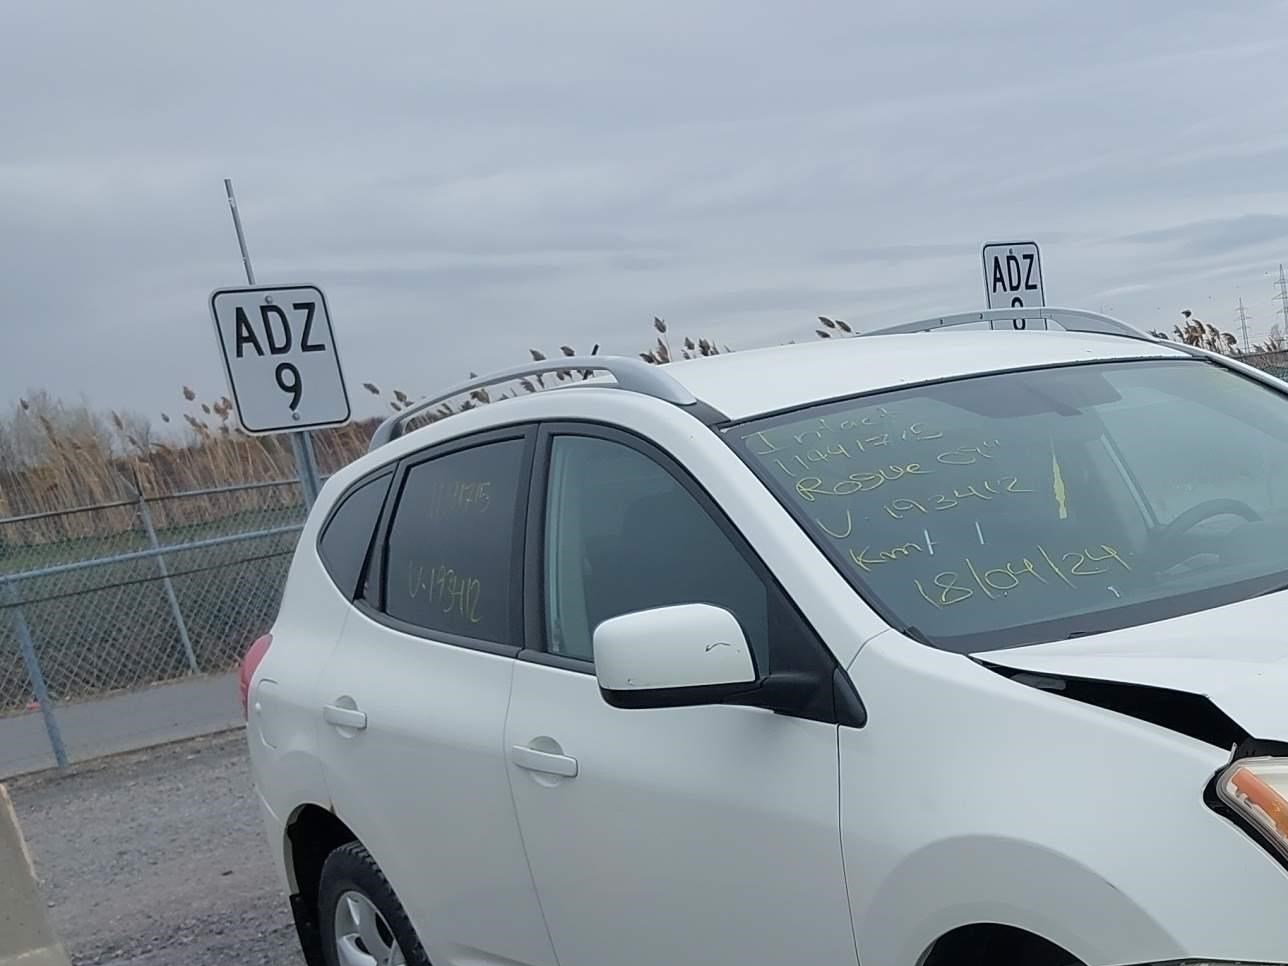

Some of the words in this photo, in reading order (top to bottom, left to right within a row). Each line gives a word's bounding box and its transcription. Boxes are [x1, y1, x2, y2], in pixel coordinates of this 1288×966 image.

[992, 253, 1039, 294] ADZ
[235, 301, 327, 359] ADZ
[274, 362, 303, 412] 9
[913, 544, 1132, 611] 18/04/24
